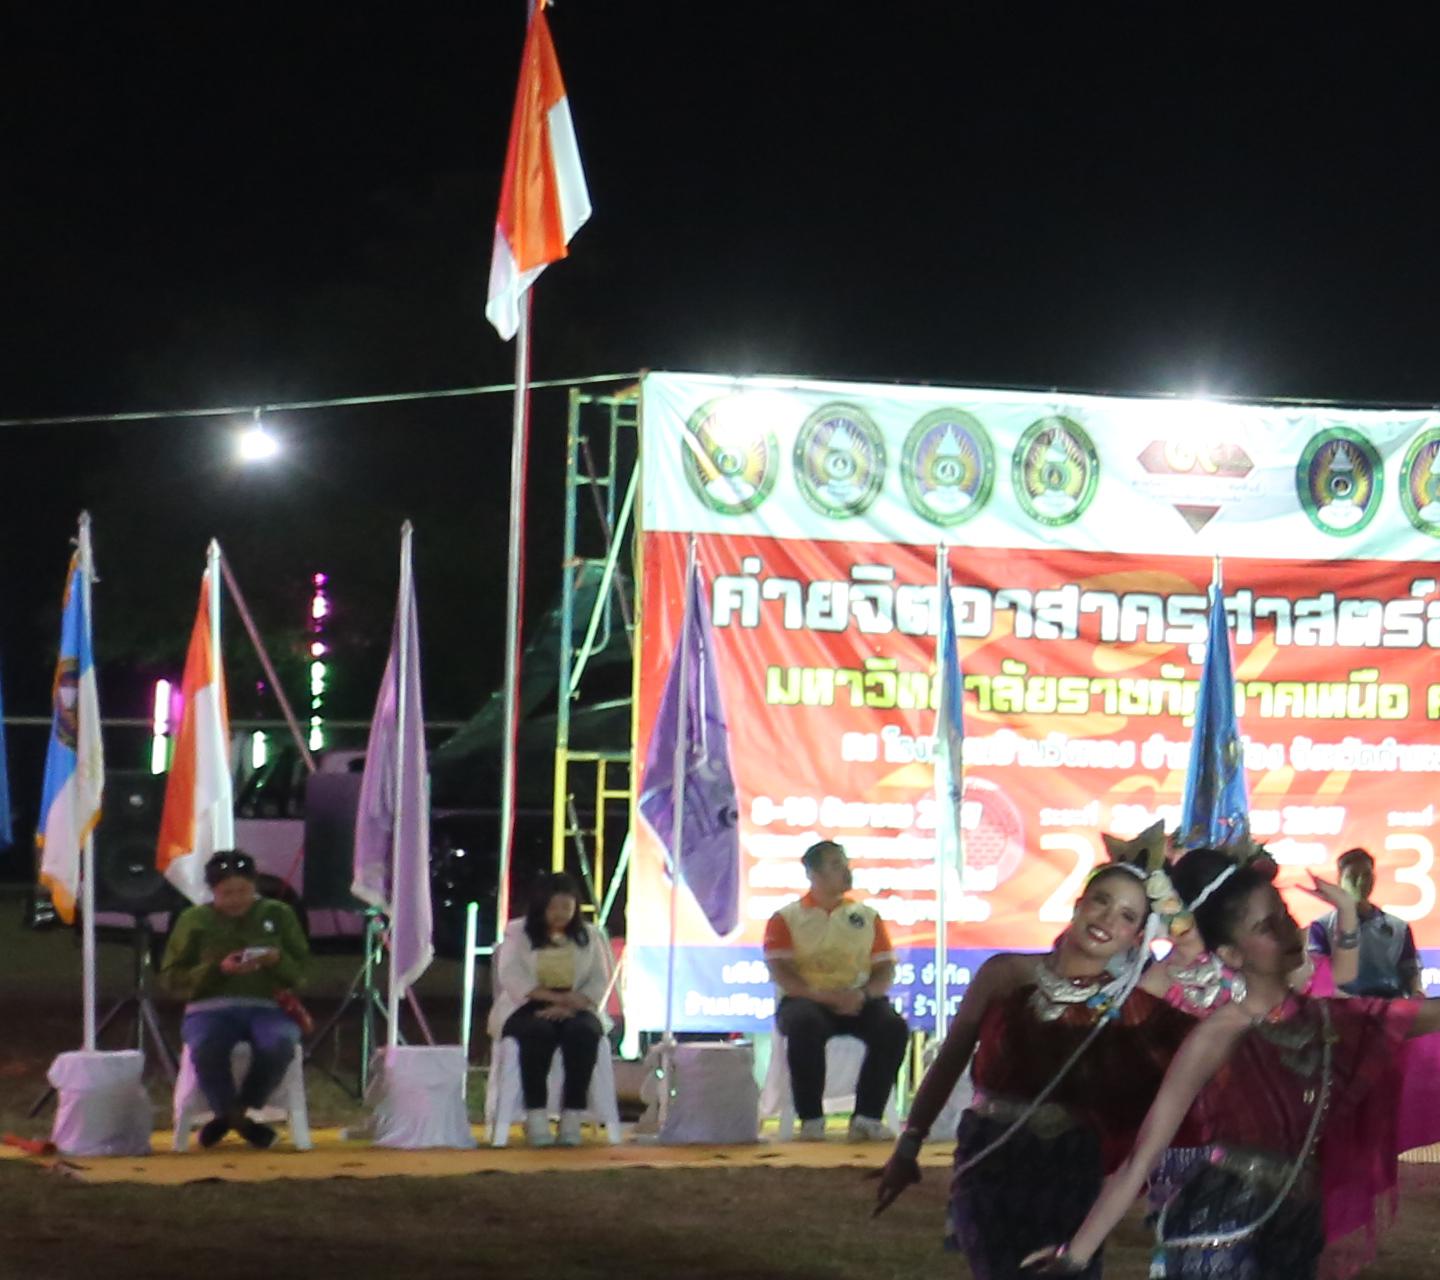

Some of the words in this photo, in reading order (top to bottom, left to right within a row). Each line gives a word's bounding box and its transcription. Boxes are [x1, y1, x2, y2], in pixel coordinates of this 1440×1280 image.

[765, 656, 1410, 727] มหาวิทาลัยราชภัาคเหนือ
[1039, 832, 1096, 921] 2
[1382, 832, 1436, 921] 3
